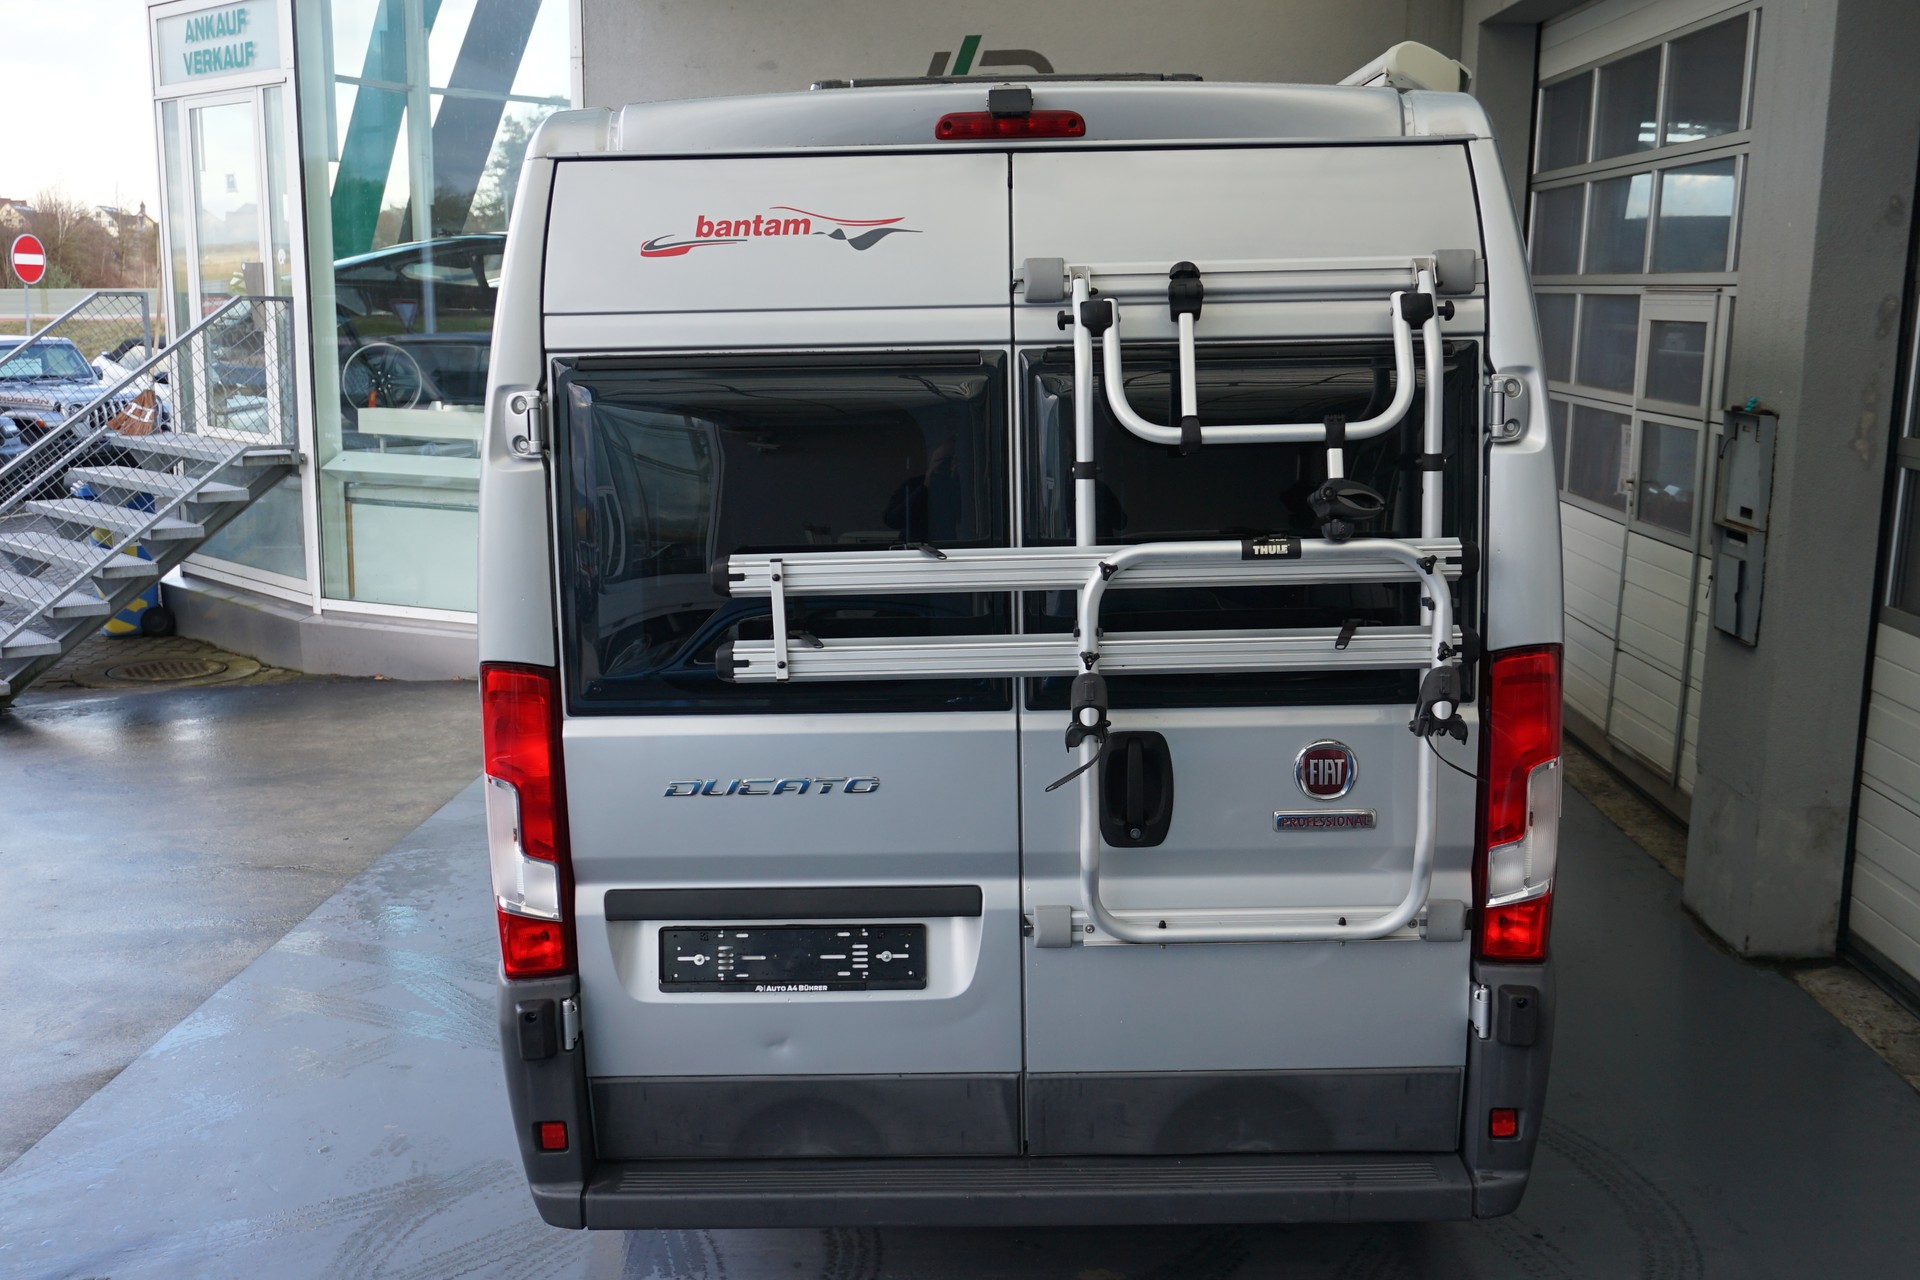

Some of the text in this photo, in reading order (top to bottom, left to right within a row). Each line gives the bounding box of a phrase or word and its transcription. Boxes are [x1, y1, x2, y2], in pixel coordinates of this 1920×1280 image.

[185, 8, 246, 44] ANKAUF
[183, 41, 254, 76] VERKAUF
[695, 215, 811, 238] bantam
[1252, 544, 1288, 555] THULE
[1309, 759, 1345, 785] FIAT
[663, 776, 881, 797] DUCATO
[1281, 815, 1369, 828] PROFESSIONAL
[787, 984, 798, 992] A4
